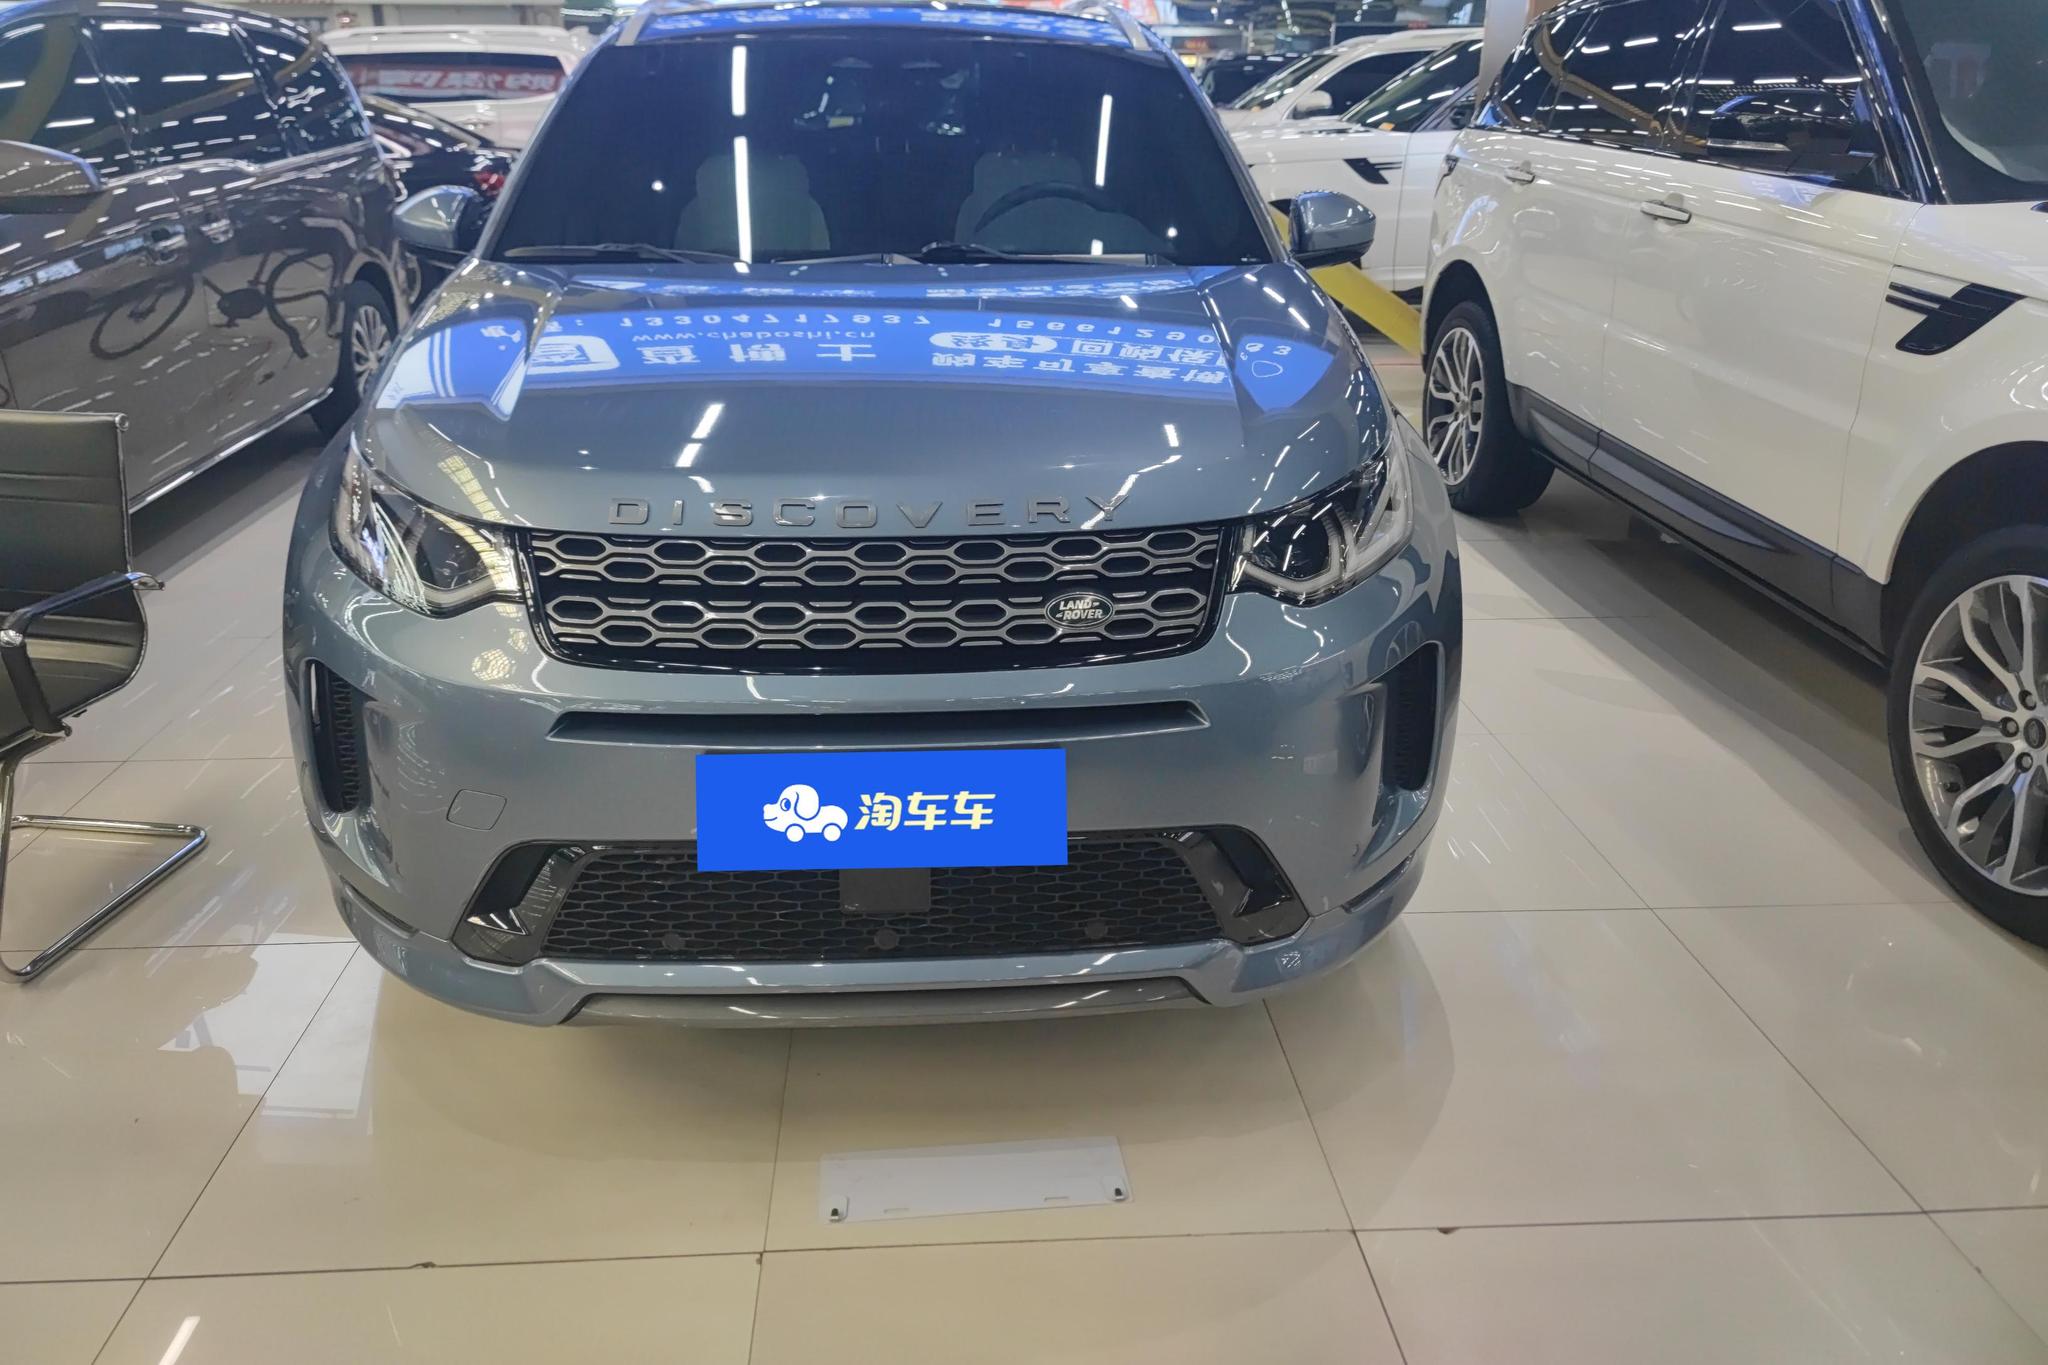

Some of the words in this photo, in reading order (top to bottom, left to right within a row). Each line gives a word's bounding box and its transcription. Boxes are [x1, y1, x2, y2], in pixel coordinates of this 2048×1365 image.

[608, 494, 1128, 528] DISCOVERY
[1059, 600, 1092, 610] LAND
[1063, 609, 1103, 620] ROVER
